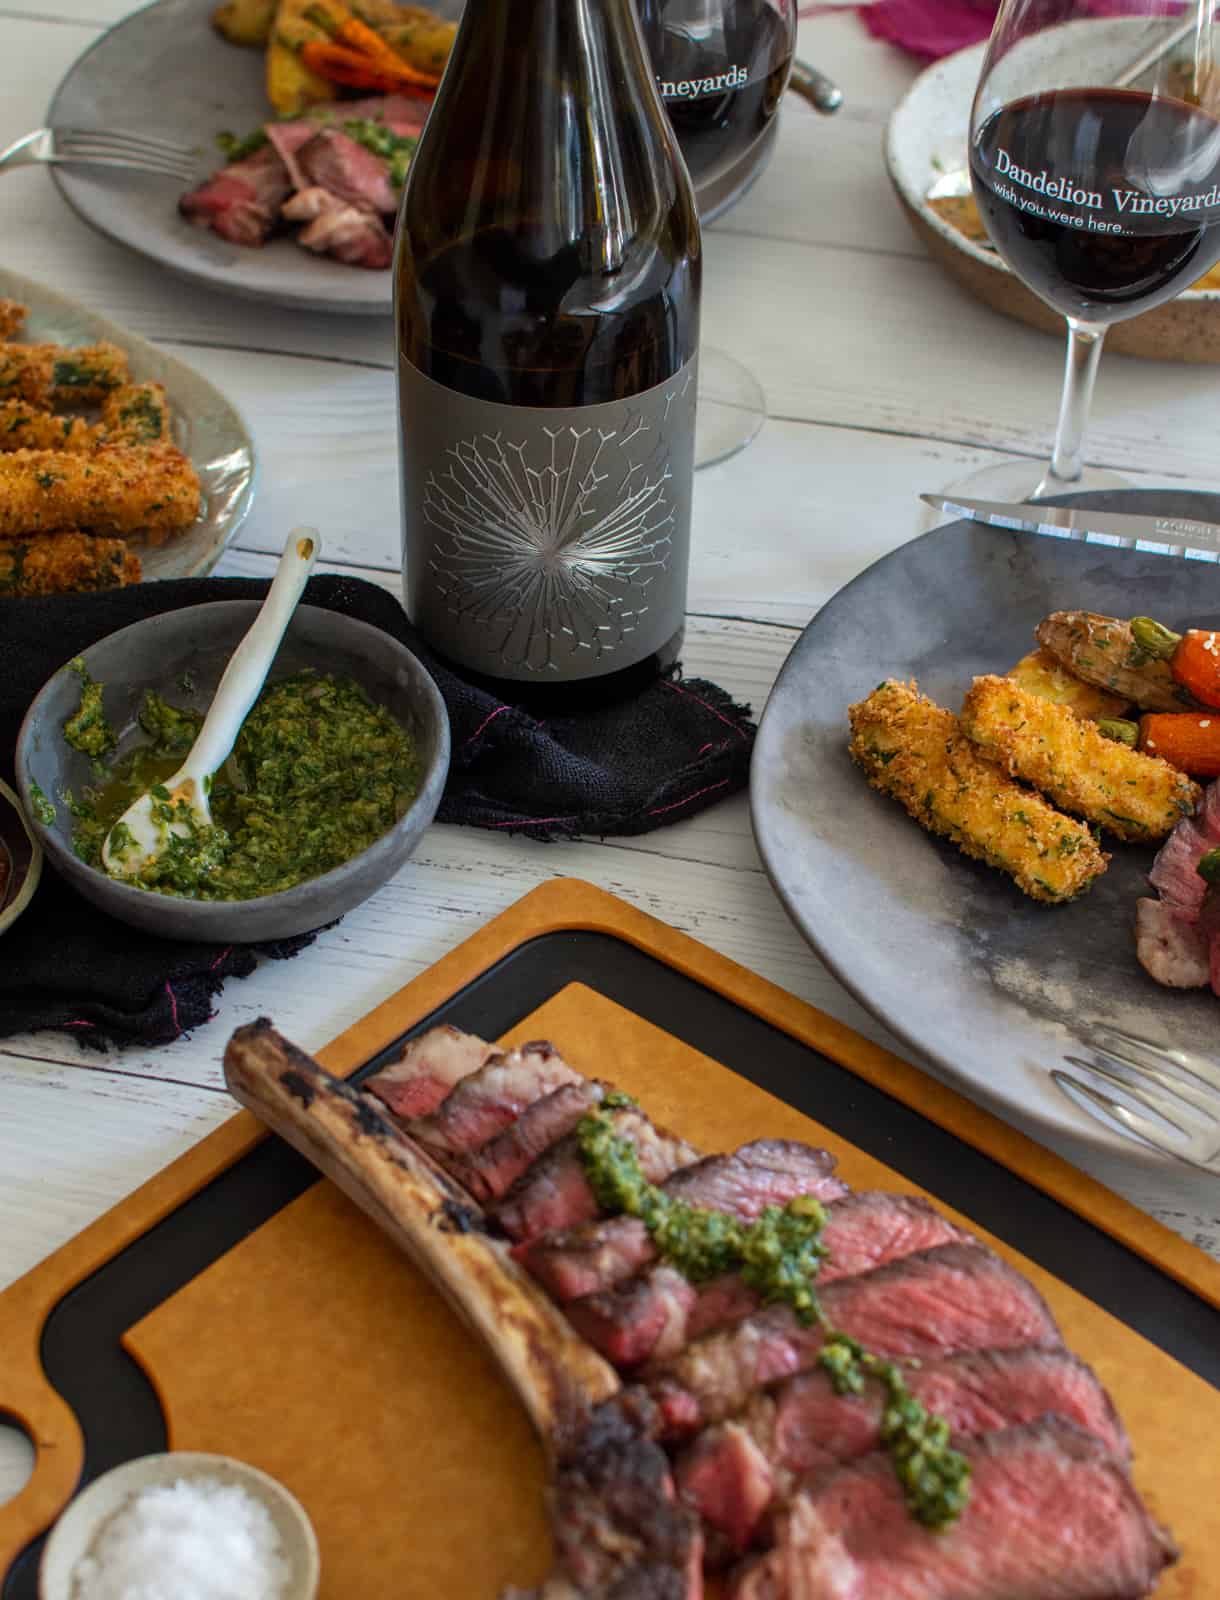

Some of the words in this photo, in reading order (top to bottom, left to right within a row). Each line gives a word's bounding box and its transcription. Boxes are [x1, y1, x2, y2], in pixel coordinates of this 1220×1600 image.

[656, 64, 748, 99] neyards
[995, 148, 1103, 209] Dandelion
[993, 181, 1018, 205] wish
[1019, 196, 1045, 215] you
[1047, 208, 1084, 227] were
[1088, 215, 1135, 235] here...
